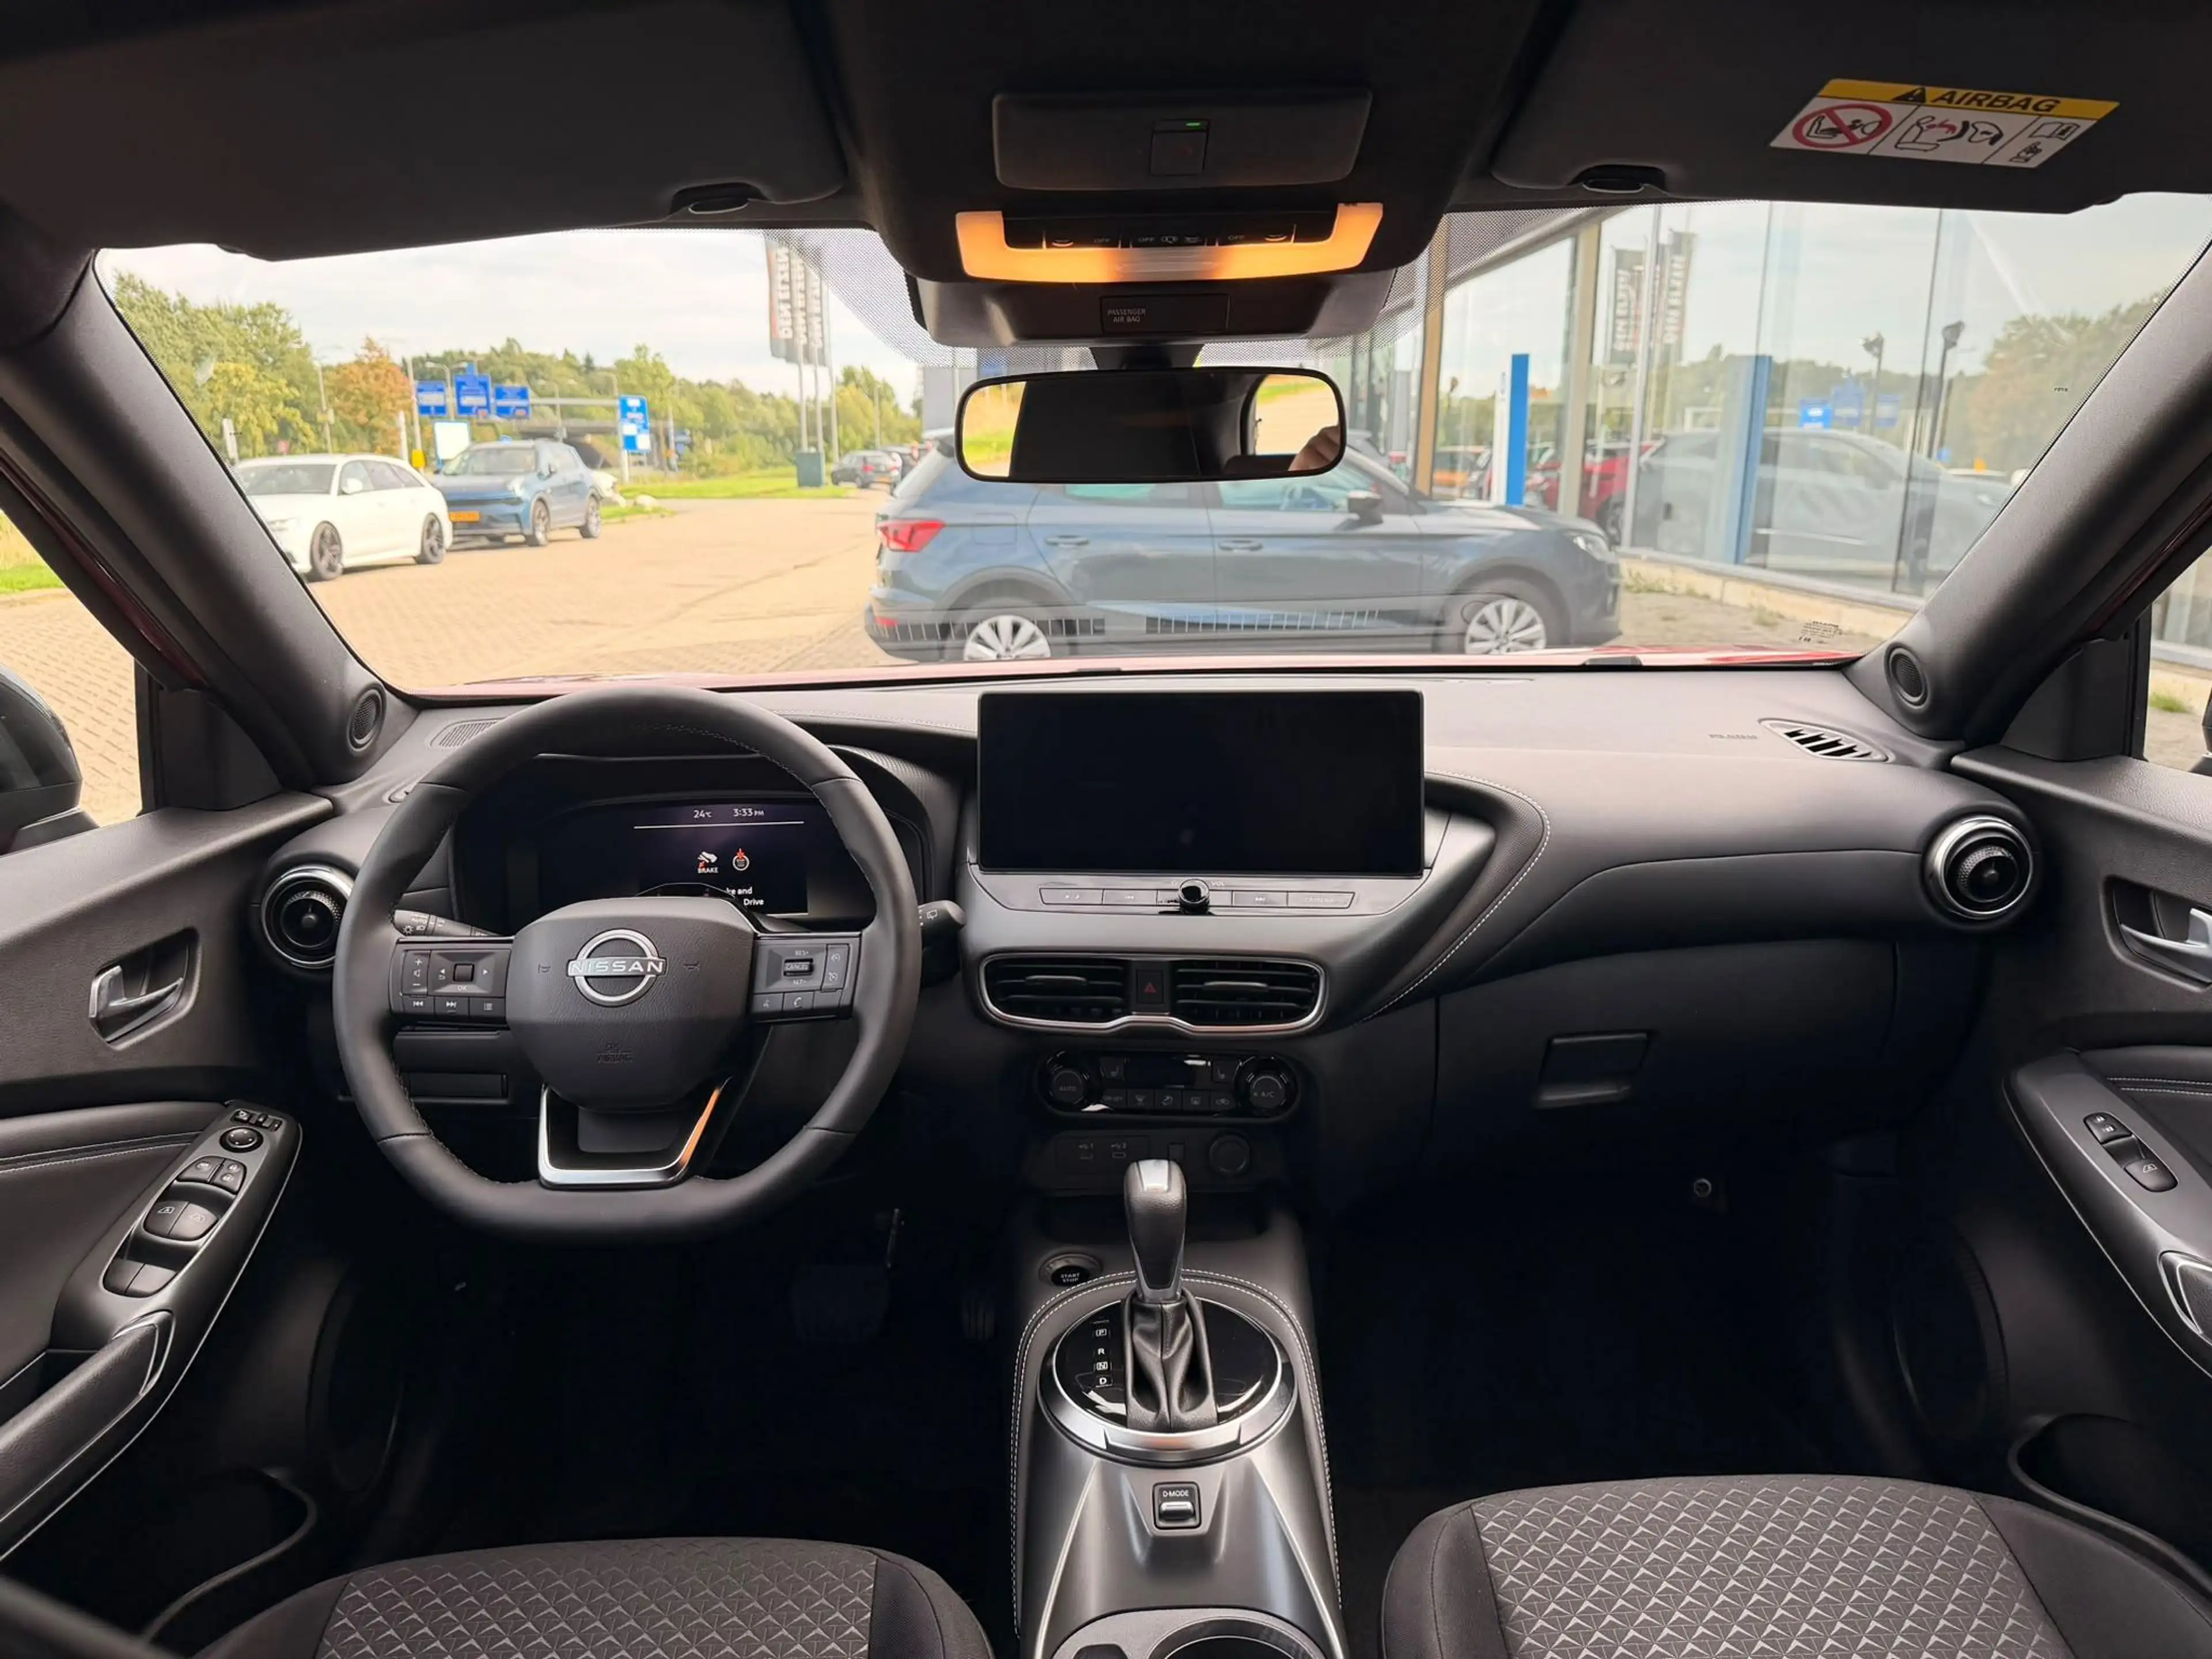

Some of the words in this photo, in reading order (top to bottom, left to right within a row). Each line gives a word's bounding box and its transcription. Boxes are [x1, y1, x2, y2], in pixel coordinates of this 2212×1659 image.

[1933, 90, 2061, 112] AIRBAG
[1107, 308, 1146, 316] PASSENGER
[733, 808, 753, 816] 3:33
[570, 960, 663, 974] NISSAN
